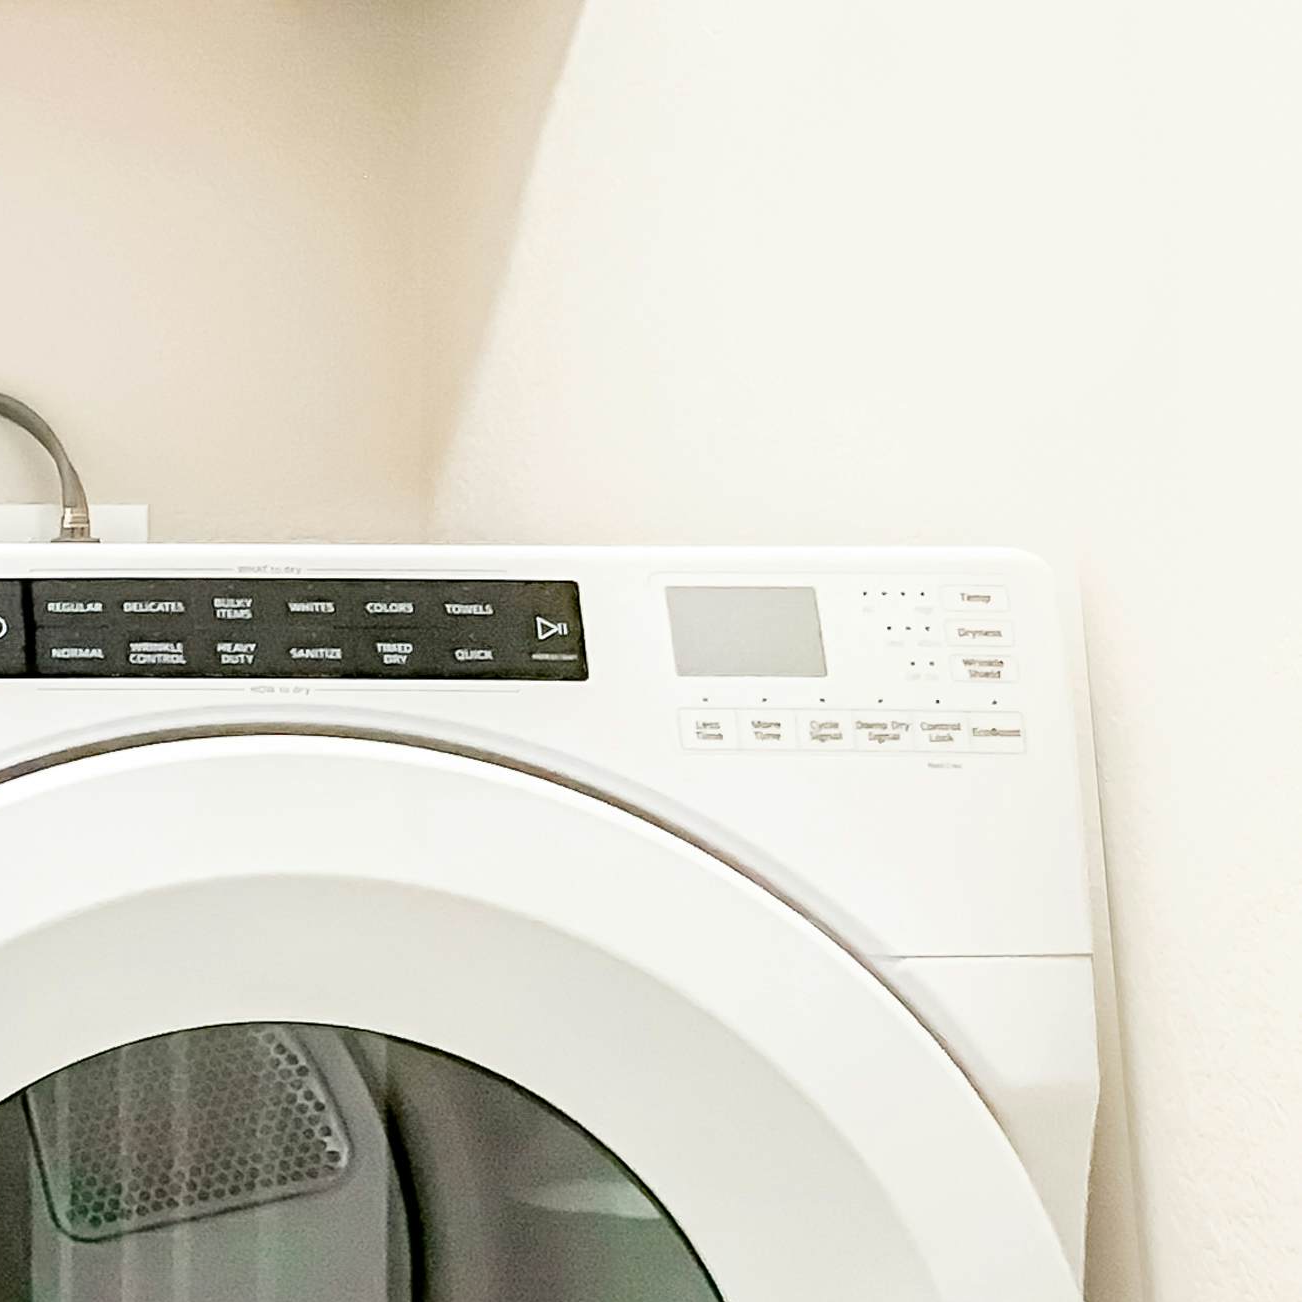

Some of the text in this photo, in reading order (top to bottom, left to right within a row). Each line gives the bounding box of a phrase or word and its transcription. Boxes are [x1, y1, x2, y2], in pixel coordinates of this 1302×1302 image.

[47, 603, 103, 612] REGULAR
[123, 602, 185, 612] DELICATES
[213, 599, 253, 607] BULKY
[288, 603, 335, 612] WHITES
[365, 603, 414, 613] COLORS
[445, 604, 494, 614] TOWELS
[216, 609, 253, 618] ITEMS
[216, 643, 256, 652] HEAVY
[51, 649, 104, 658] NORMAL
[289, 648, 342, 658] SANITIZE
[454, 650, 493, 660] QUICK
[129, 654, 187, 664] CONTROL
[221, 654, 254, 663] DUTY
[383, 655, 408, 663] DRY
